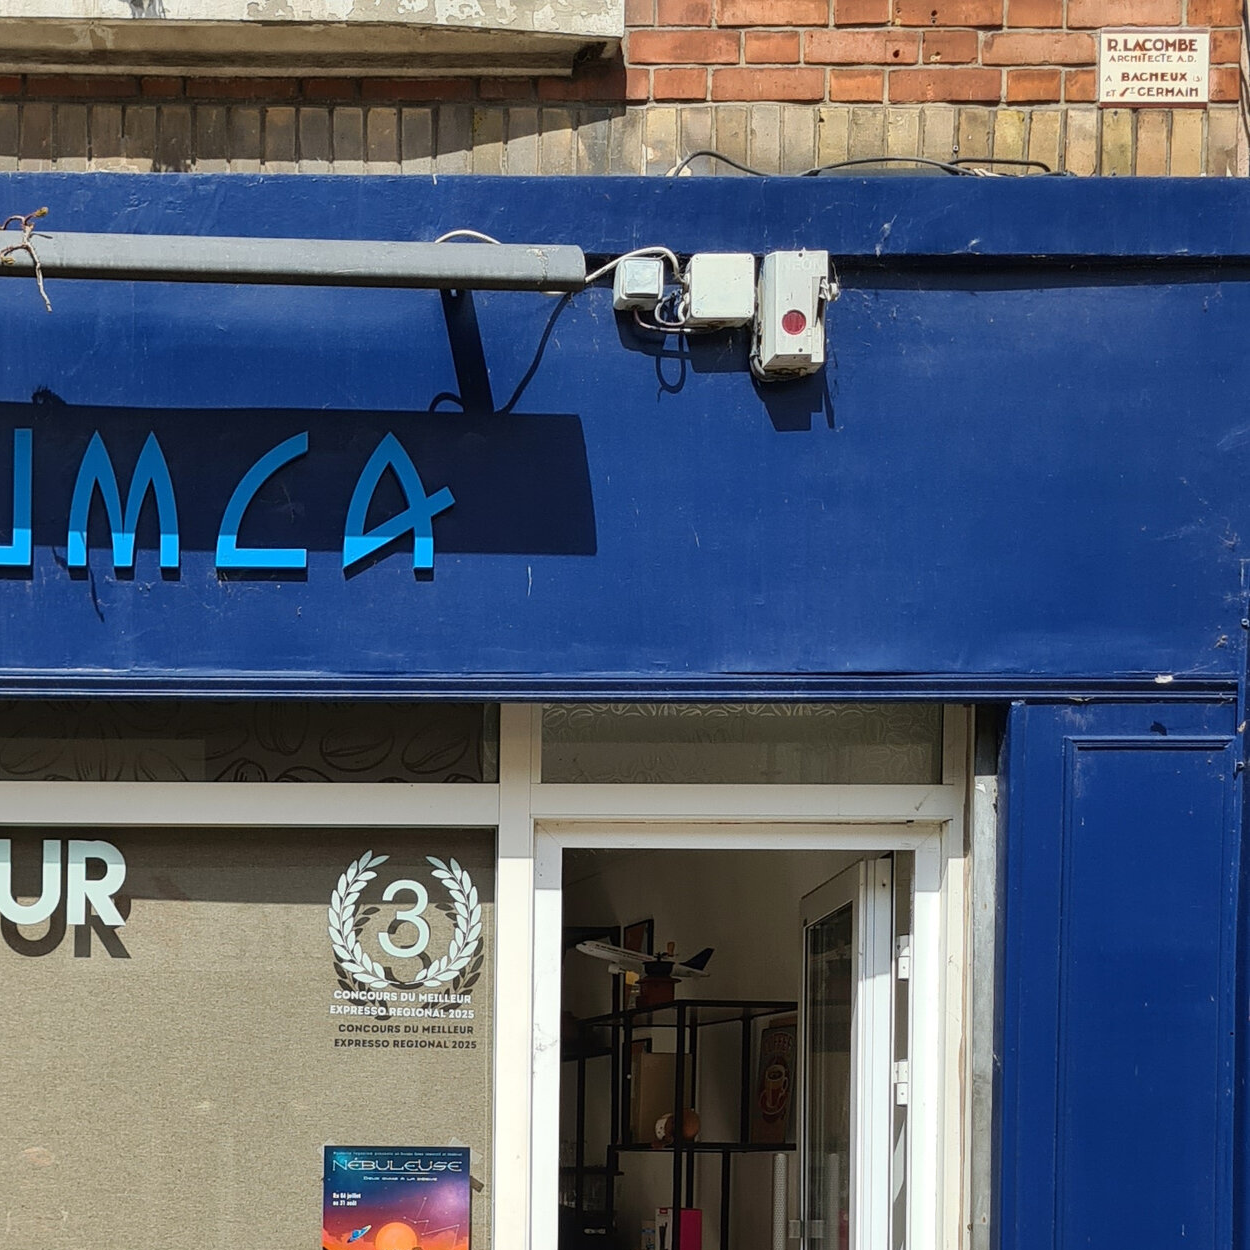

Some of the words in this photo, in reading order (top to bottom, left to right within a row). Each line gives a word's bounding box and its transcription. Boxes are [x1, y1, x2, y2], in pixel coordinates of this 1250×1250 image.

[1108, 53, 1173, 63] ARCHITECTE
[1176, 55, 1197, 63] A.D.
[1106, 89, 1115, 97] ET
[1137, 87, 1199, 97] GERMAIN
[781, 259, 824, 273] NEON
[378, 879, 431, 958] 3
[333, 990, 398, 1002] CONCOURS
[400, 992, 416, 1002] DU
[418, 993, 472, 1004] MEILLEUR
[330, 1005, 387, 1017] EXPRESSO
[389, 1007, 446, 1018] REGIONAL
[449, 1008, 475, 1019] 2025
[332, 1157, 463, 1172] NÉBULEUSE
